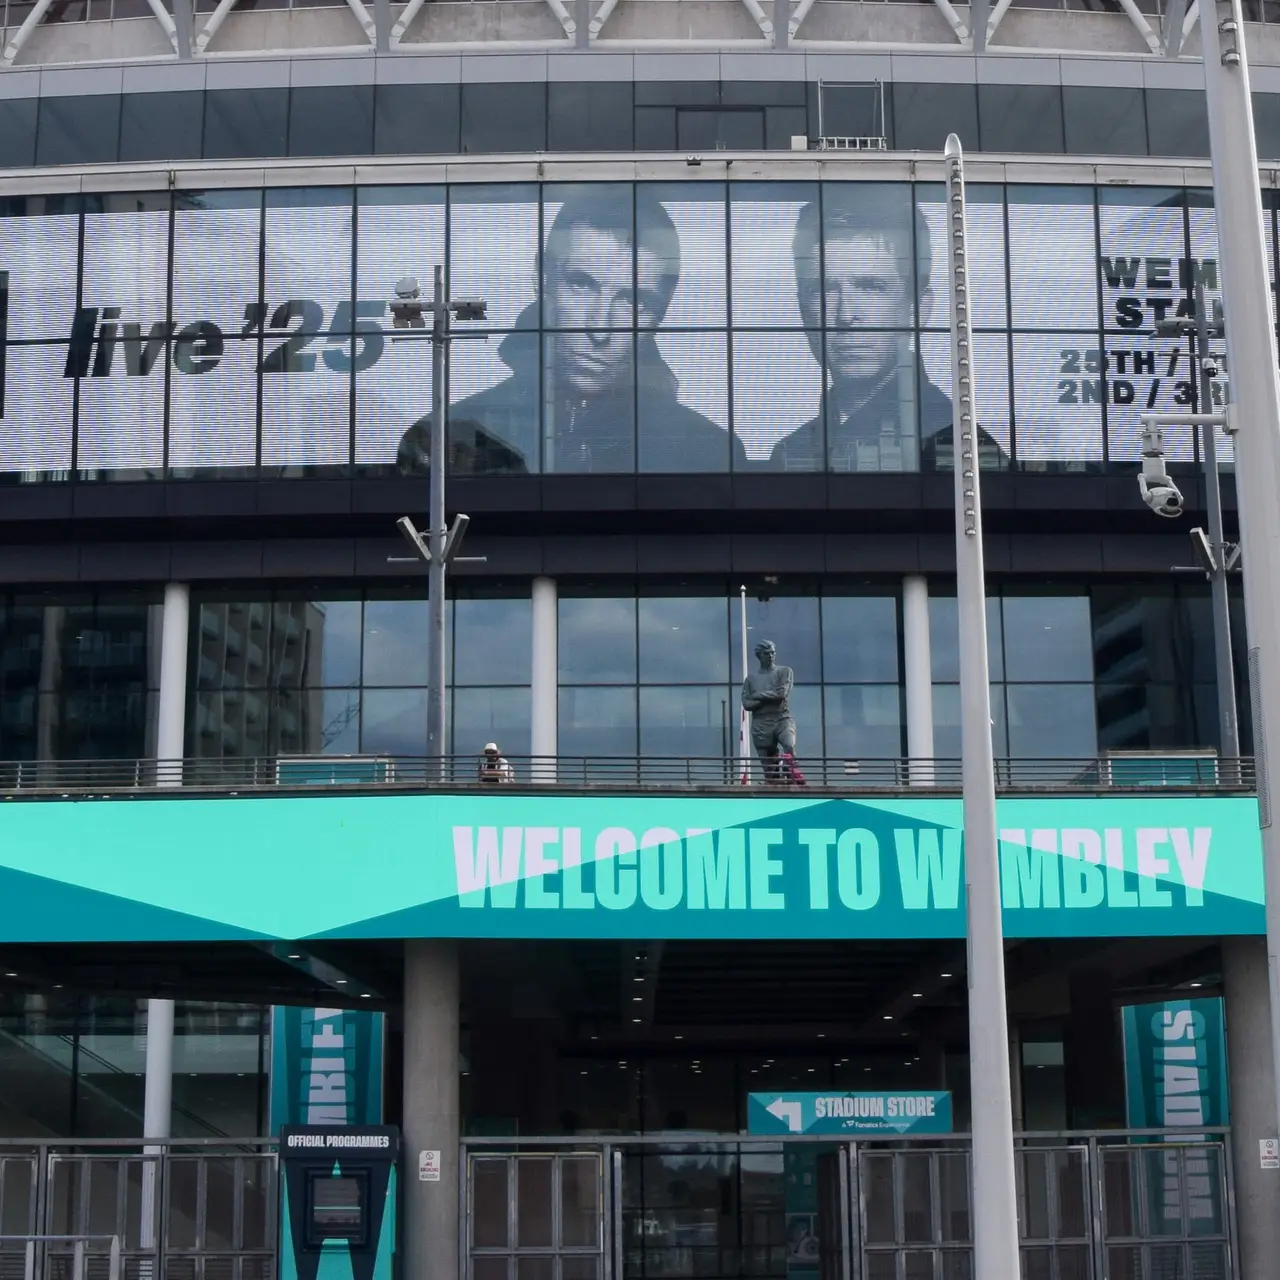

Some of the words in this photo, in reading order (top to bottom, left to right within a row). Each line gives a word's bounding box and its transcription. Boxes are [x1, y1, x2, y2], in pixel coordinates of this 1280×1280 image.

[63, 307, 221, 378] live
[1059, 349, 1155, 376] 25TH
[1057, 378, 1135, 405] 2ND
[452, 825, 784, 910] WELCOME
[798, 827, 879, 911] TO
[894, 826, 1212, 910] WMBLEY
[815, 1096, 884, 1118] STADIUM
[888, 1095, 935, 1117] STORE
[288, 1135, 325, 1147] OFFICIAL
[326, 1135, 390, 1147] PROGRAMMES
